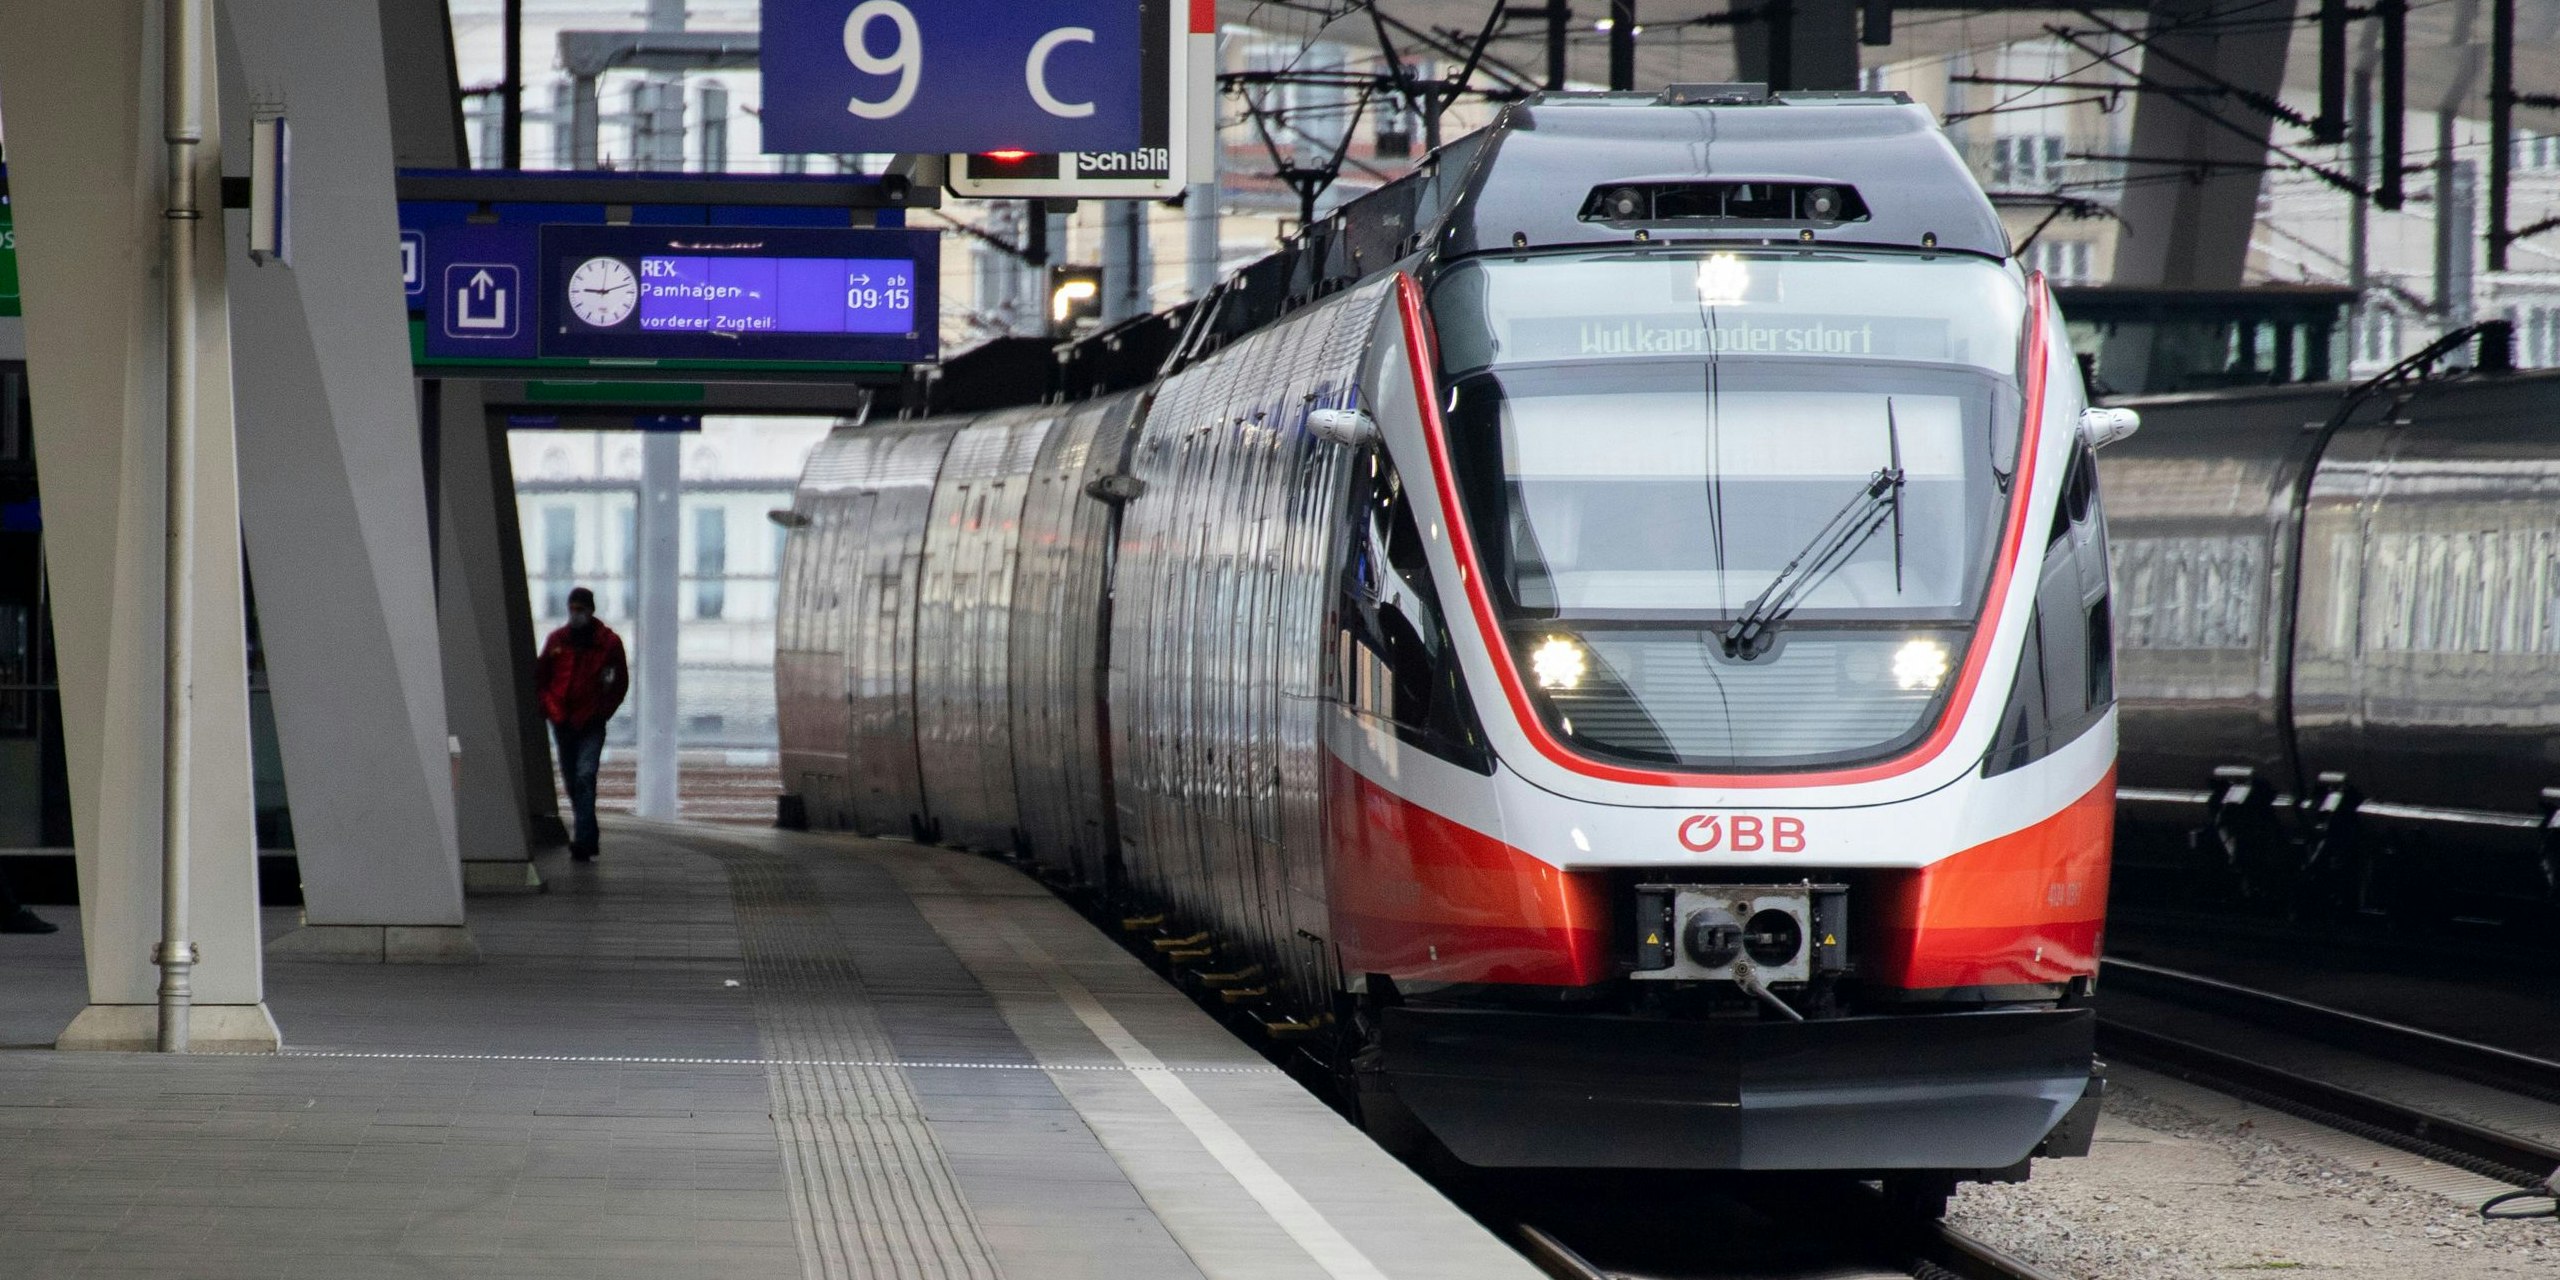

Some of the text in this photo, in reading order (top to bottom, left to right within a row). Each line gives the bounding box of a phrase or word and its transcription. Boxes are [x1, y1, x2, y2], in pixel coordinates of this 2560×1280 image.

[843, 0, 921, 119] 9
[641, 260, 677, 277] REX
[887, 275, 906, 286] ab
[641, 283, 739, 300] Pamhagen
[848, 288, 909, 309] 09:15
[641, 315, 776, 331] vorderer Zugteil:
[1581, 319, 1873, 354] Wulkaprodersdorf
[1678, 815, 1806, 852] ÖBB
